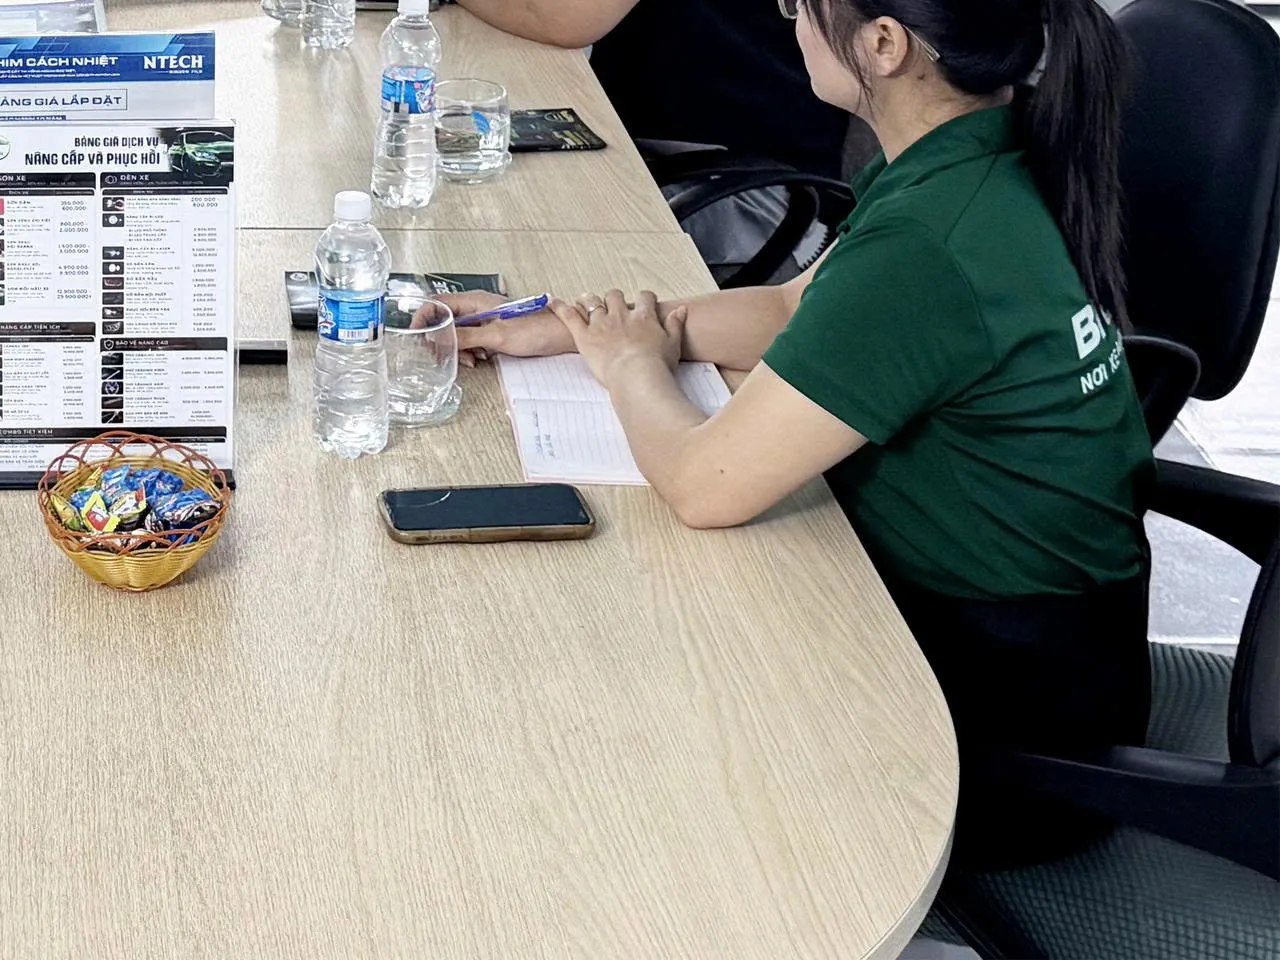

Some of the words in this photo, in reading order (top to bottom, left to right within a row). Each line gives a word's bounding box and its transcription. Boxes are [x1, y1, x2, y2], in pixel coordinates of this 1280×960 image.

[26, 56, 69, 67] CÁCH
[72, 55, 119, 68] NHIỆT
[144, 55, 203, 69] NTECH
[35, 96, 58, 107] GIÁ
[62, 94, 90, 106] LẮP
[92, 95, 122, 107] ĐẶT
[74, 136, 101, 148] BẢNG
[103, 136, 119, 147] GIÁ
[122, 136, 144, 149] DỊCH
[146, 136, 159, 150] VỤ
[25, 151, 58, 166] NÂNG
[61, 149, 85, 166] CẤP
[88, 151, 103, 165] VÀ
[106, 152, 138, 167] PHỤC
[141, 148, 160, 165] HỒI
